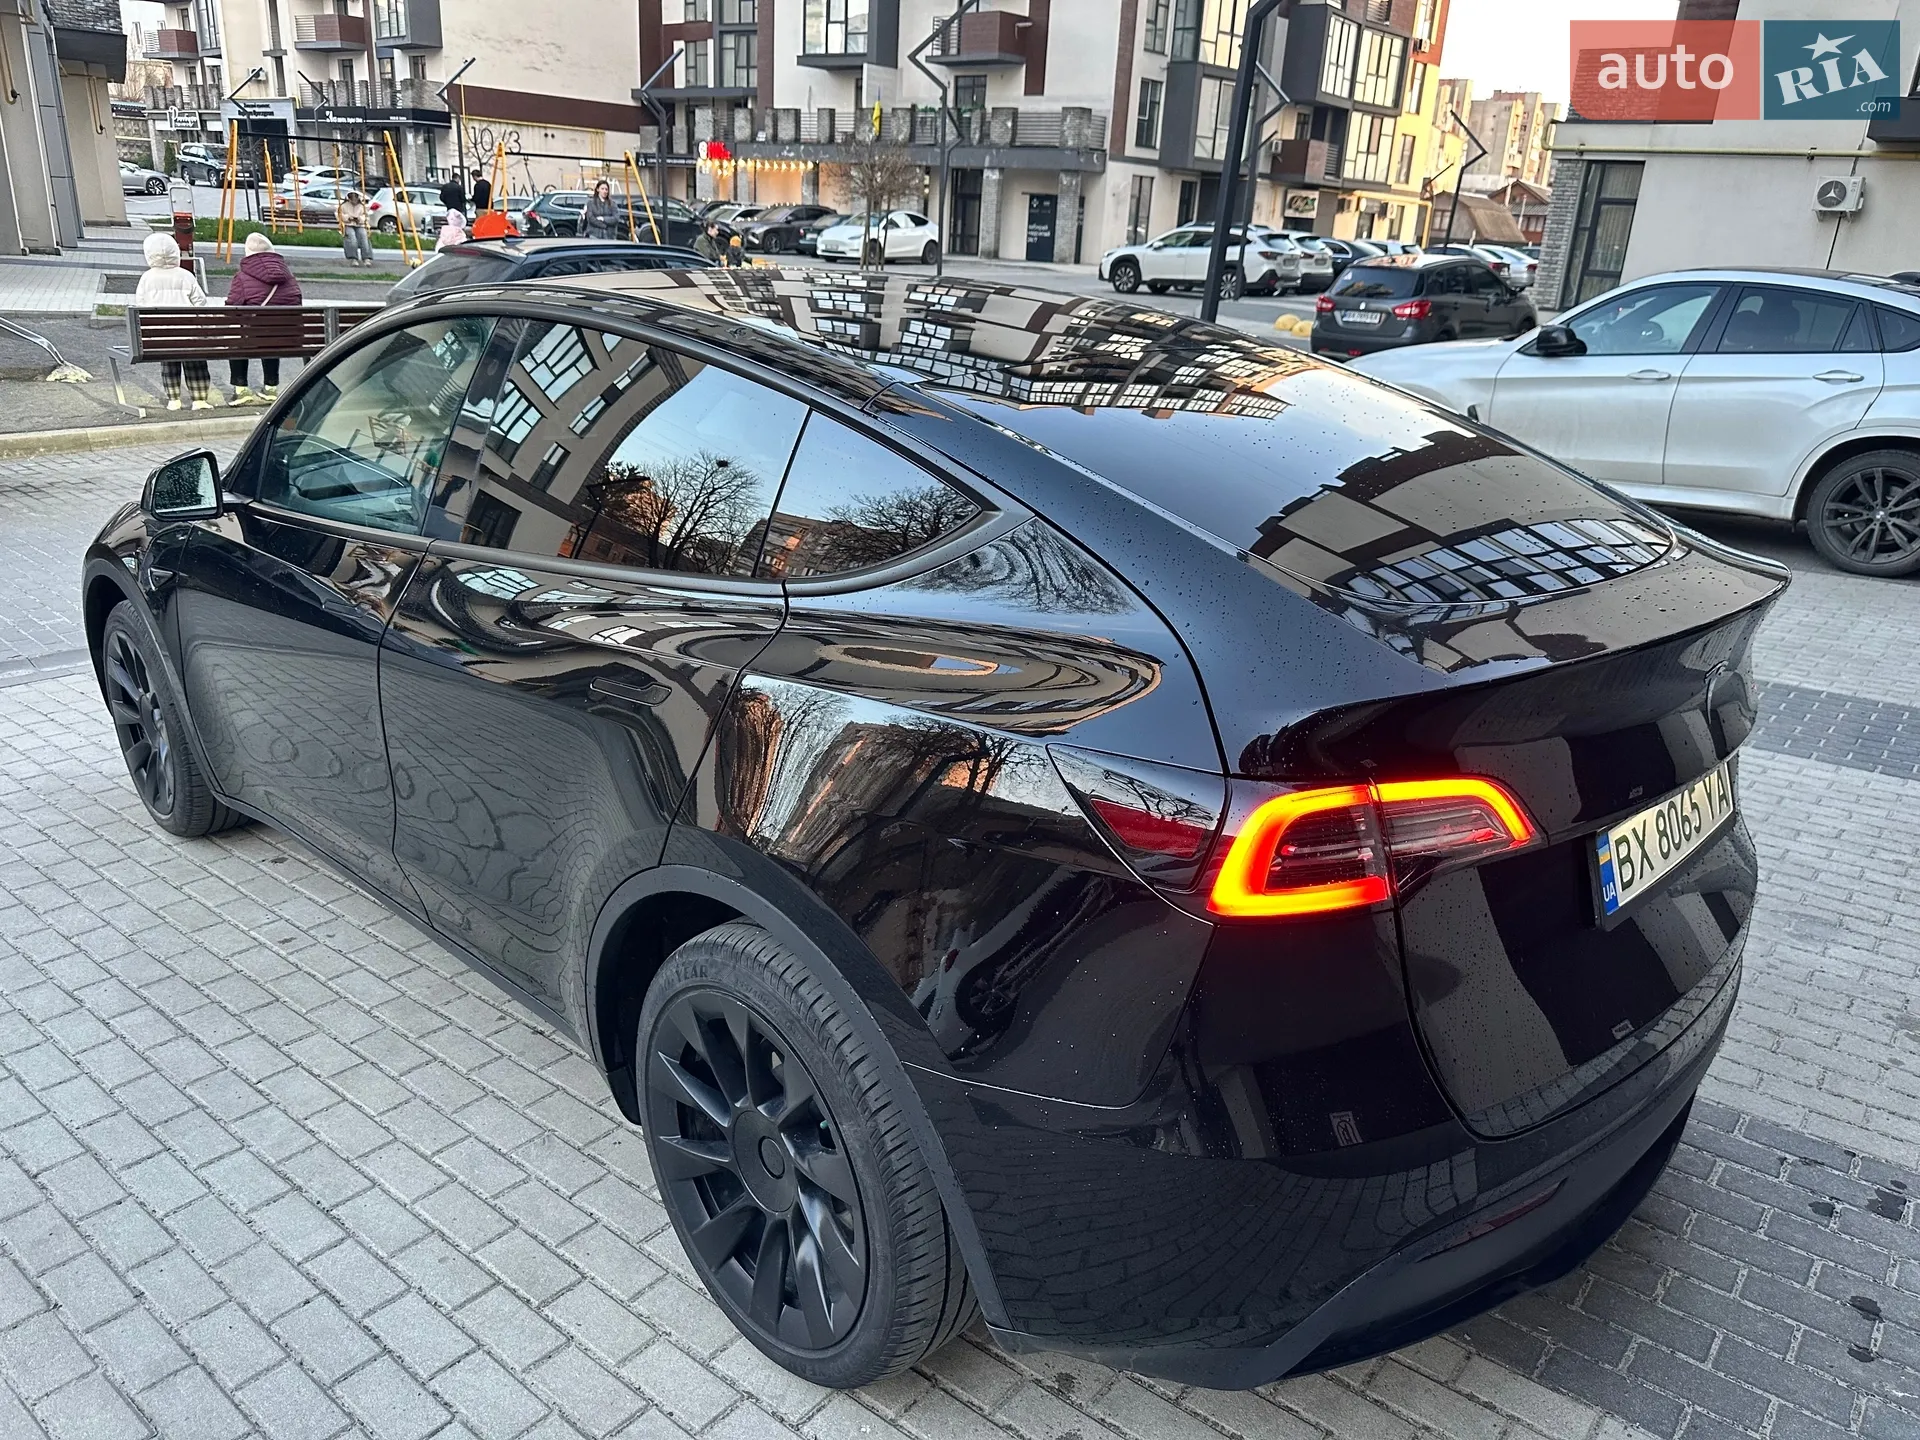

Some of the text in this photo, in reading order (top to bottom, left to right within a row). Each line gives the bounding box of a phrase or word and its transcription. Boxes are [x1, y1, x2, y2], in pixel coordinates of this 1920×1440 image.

[1614, 769, 1729, 893] BX 8065 YA
[1602, 880, 1617, 903] UA
